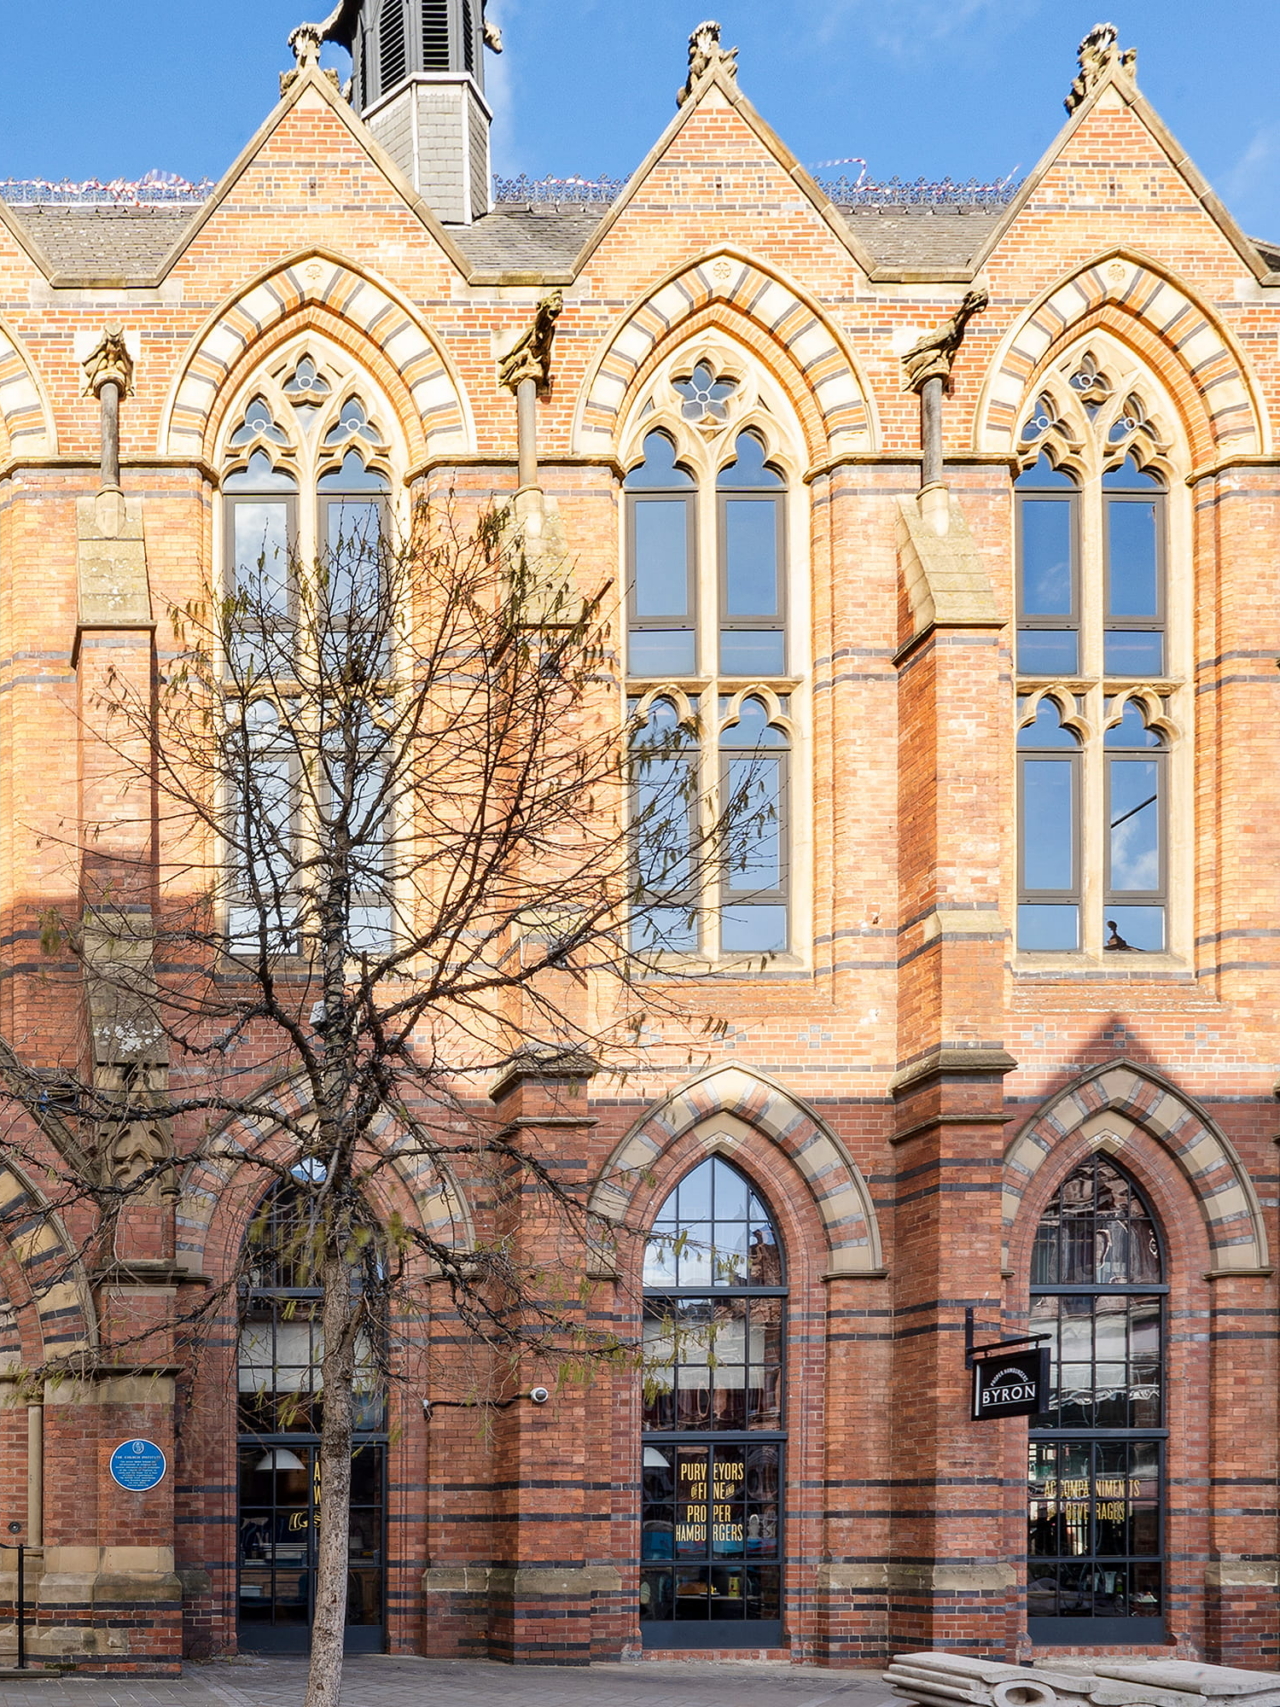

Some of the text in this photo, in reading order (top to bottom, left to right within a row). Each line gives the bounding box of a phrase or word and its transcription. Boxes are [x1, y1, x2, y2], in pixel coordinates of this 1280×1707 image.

[982, 1384, 1036, 1405] BYRON
[681, 1463, 744, 1480] PURVEYORS
[698, 1482, 726, 1500] FINE
[687, 1505, 731, 1522] PROPER
[1065, 1502, 1126, 1521] BEVERAGES
[676, 1524, 743, 1541] HAMBURGERS
